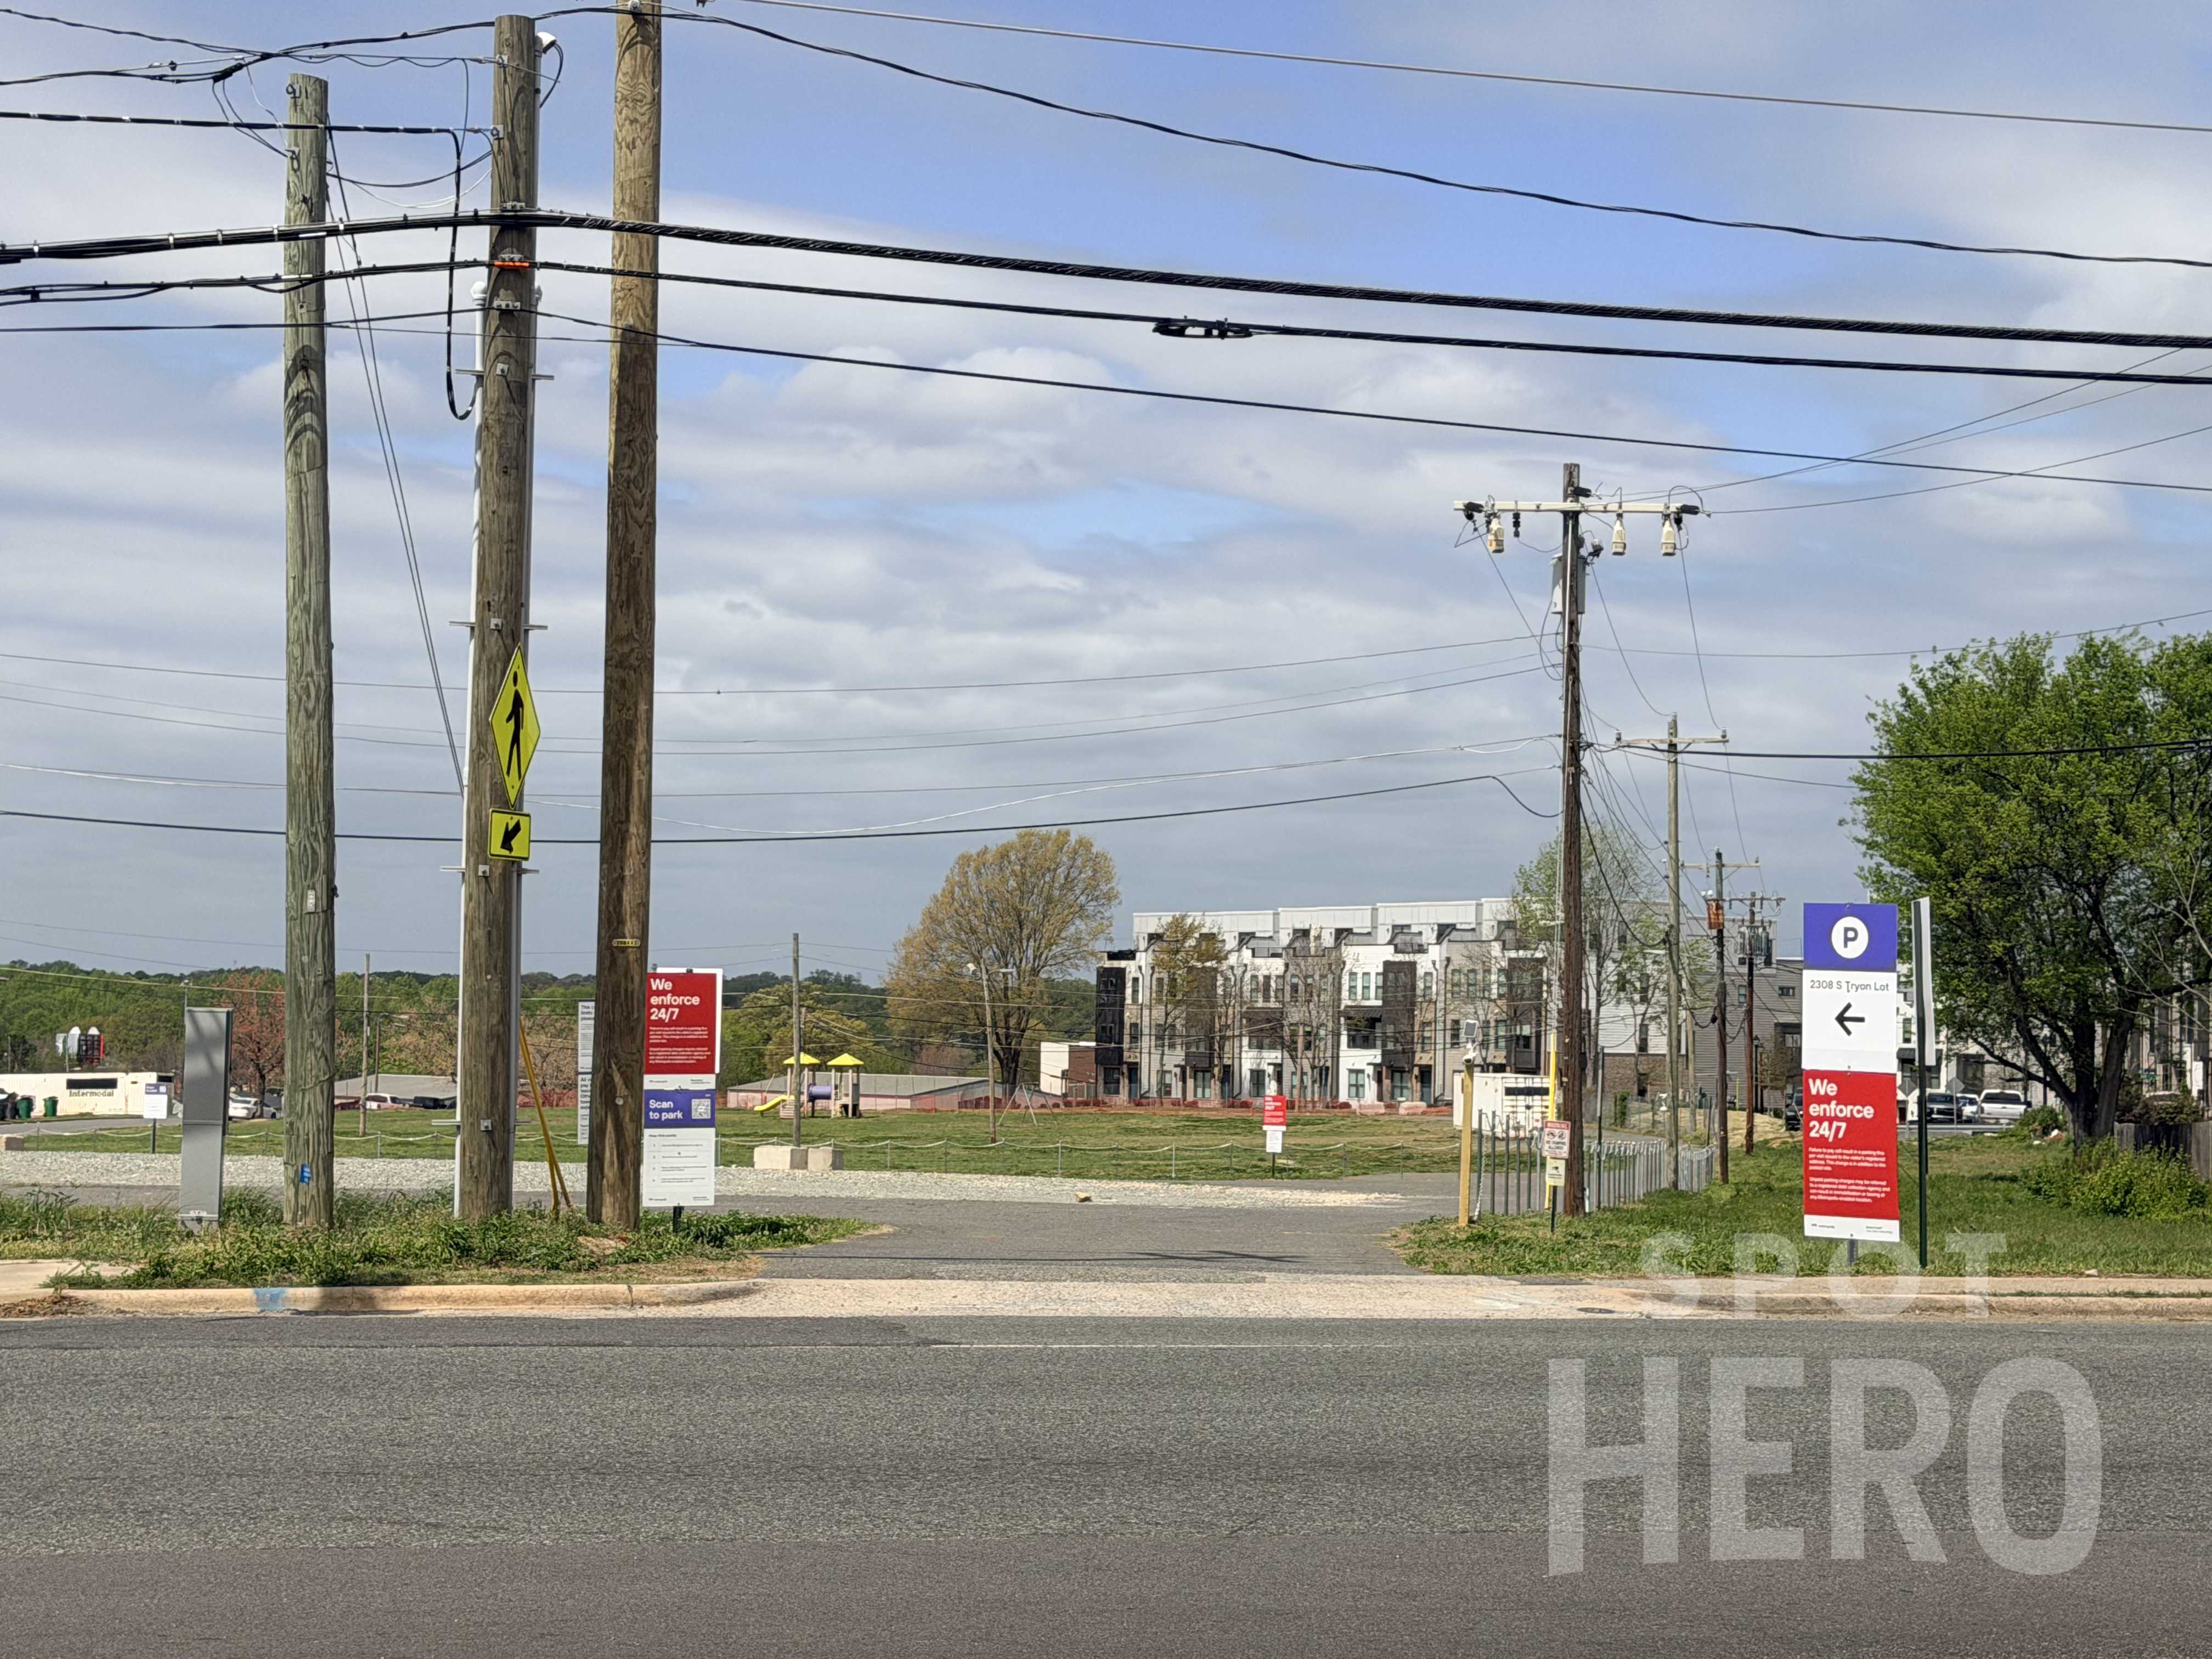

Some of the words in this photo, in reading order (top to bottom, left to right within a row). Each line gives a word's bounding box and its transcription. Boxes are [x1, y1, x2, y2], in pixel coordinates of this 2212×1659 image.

[1843, 926, 1859, 949] P
[650, 978, 673, 990] We
[1810, 980, 1833, 990] 2308
[1836, 980, 1842, 990] S
[1846, 981, 1871, 993] Tryon
[1874, 982, 1889, 991] Lot
[650, 993, 700, 1005] enforce
[650, 1008, 679, 1023] 24/7
[1808, 1078, 1838, 1096] We
[649, 1099, 674, 1109] Scan
[1809, 1100, 1874, 1119] enforce
[649, 1111, 660, 1119] to
[662, 1110, 683, 1121] park
[1809, 1120, 1847, 1142] 24/7
